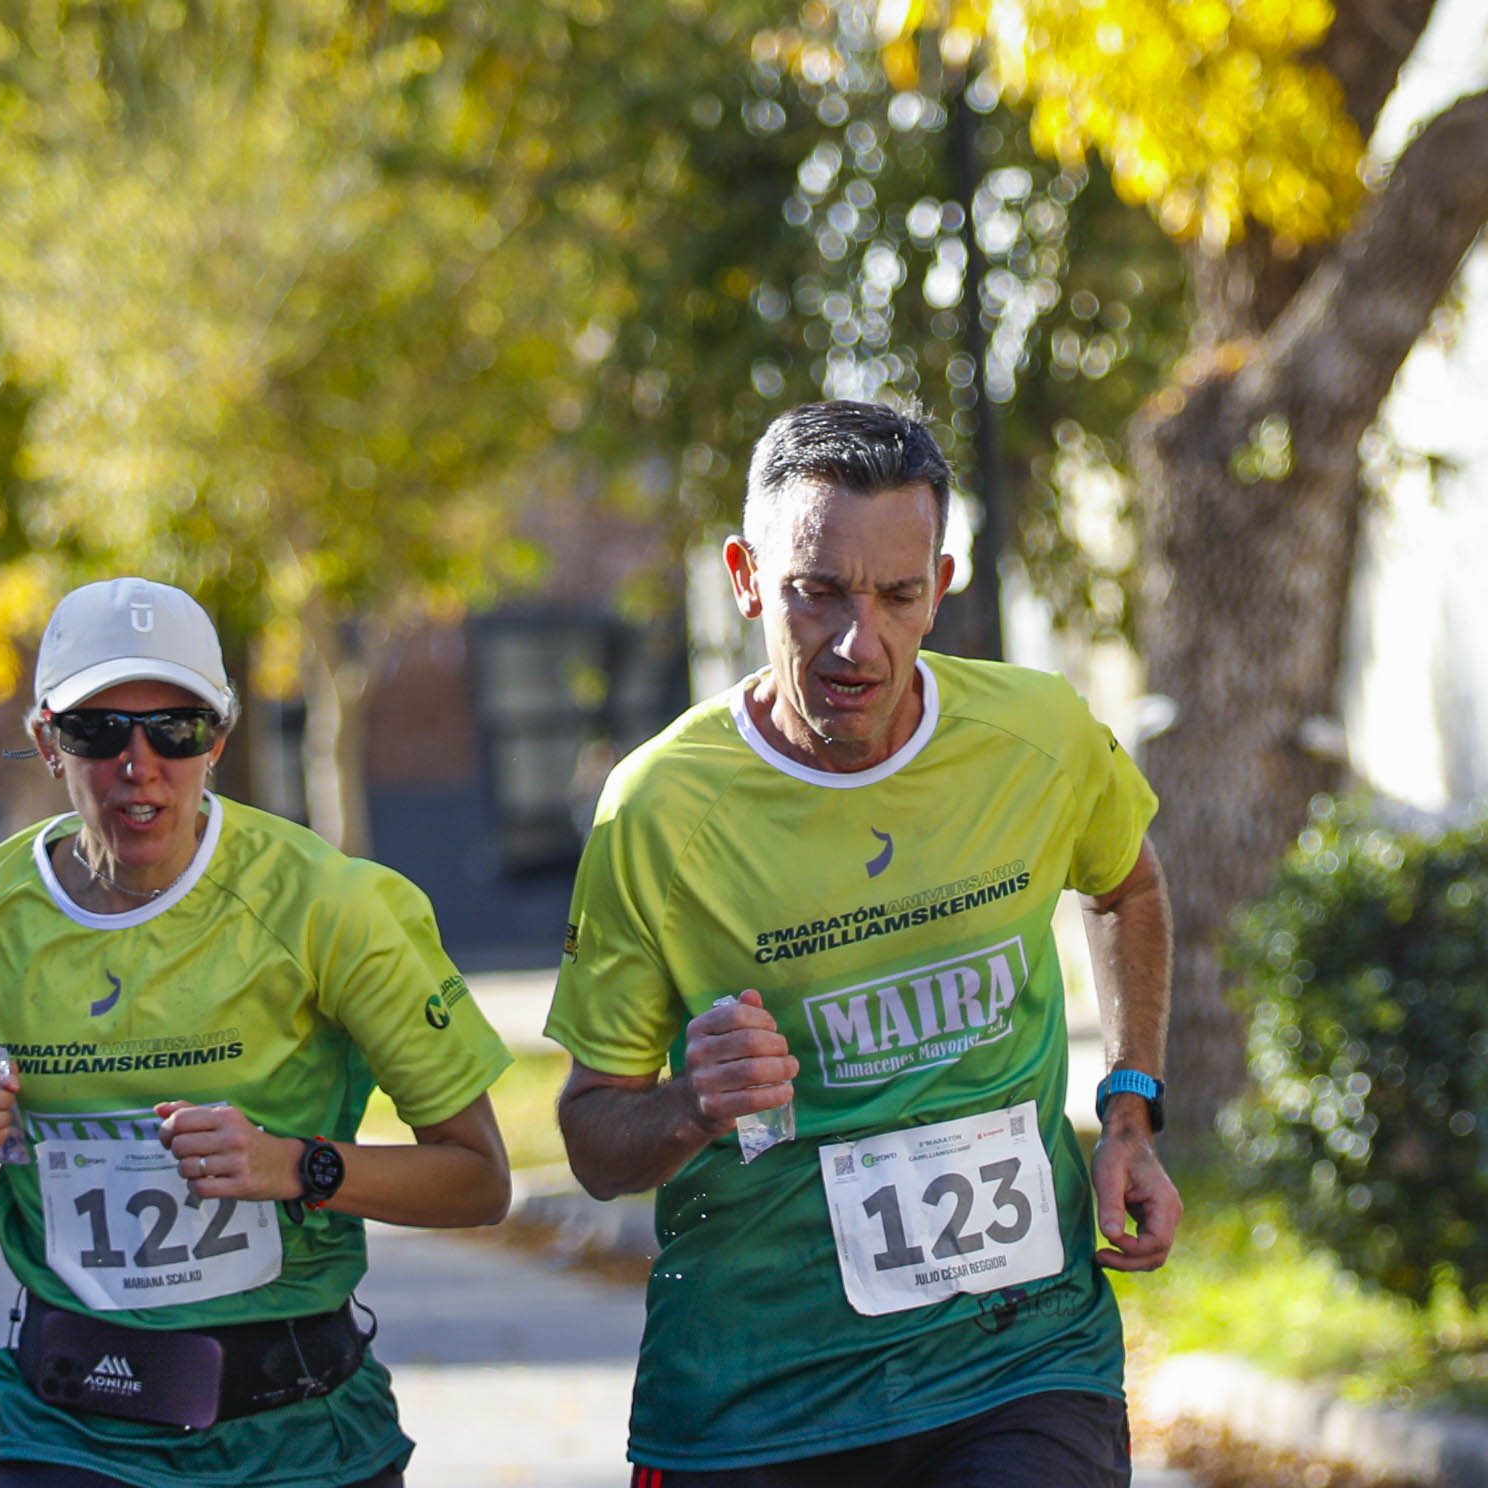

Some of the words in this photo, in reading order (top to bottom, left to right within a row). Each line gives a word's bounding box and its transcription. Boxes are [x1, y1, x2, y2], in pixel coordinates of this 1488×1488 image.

[819, 954, 1016, 1060] MAIRA
[6, 1041, 98, 1058] MARATÓN
[17, 1042, 244, 1075] WILLIAMSKEMMIS
[835, 1052, 915, 1079] Almacenes
[74, 1188, 249, 1268] 122
[862, 1157, 1032, 1271] 123
[915, 1269, 940, 1287] JULIO
[83, 1375, 143, 1393] AONIJIE
